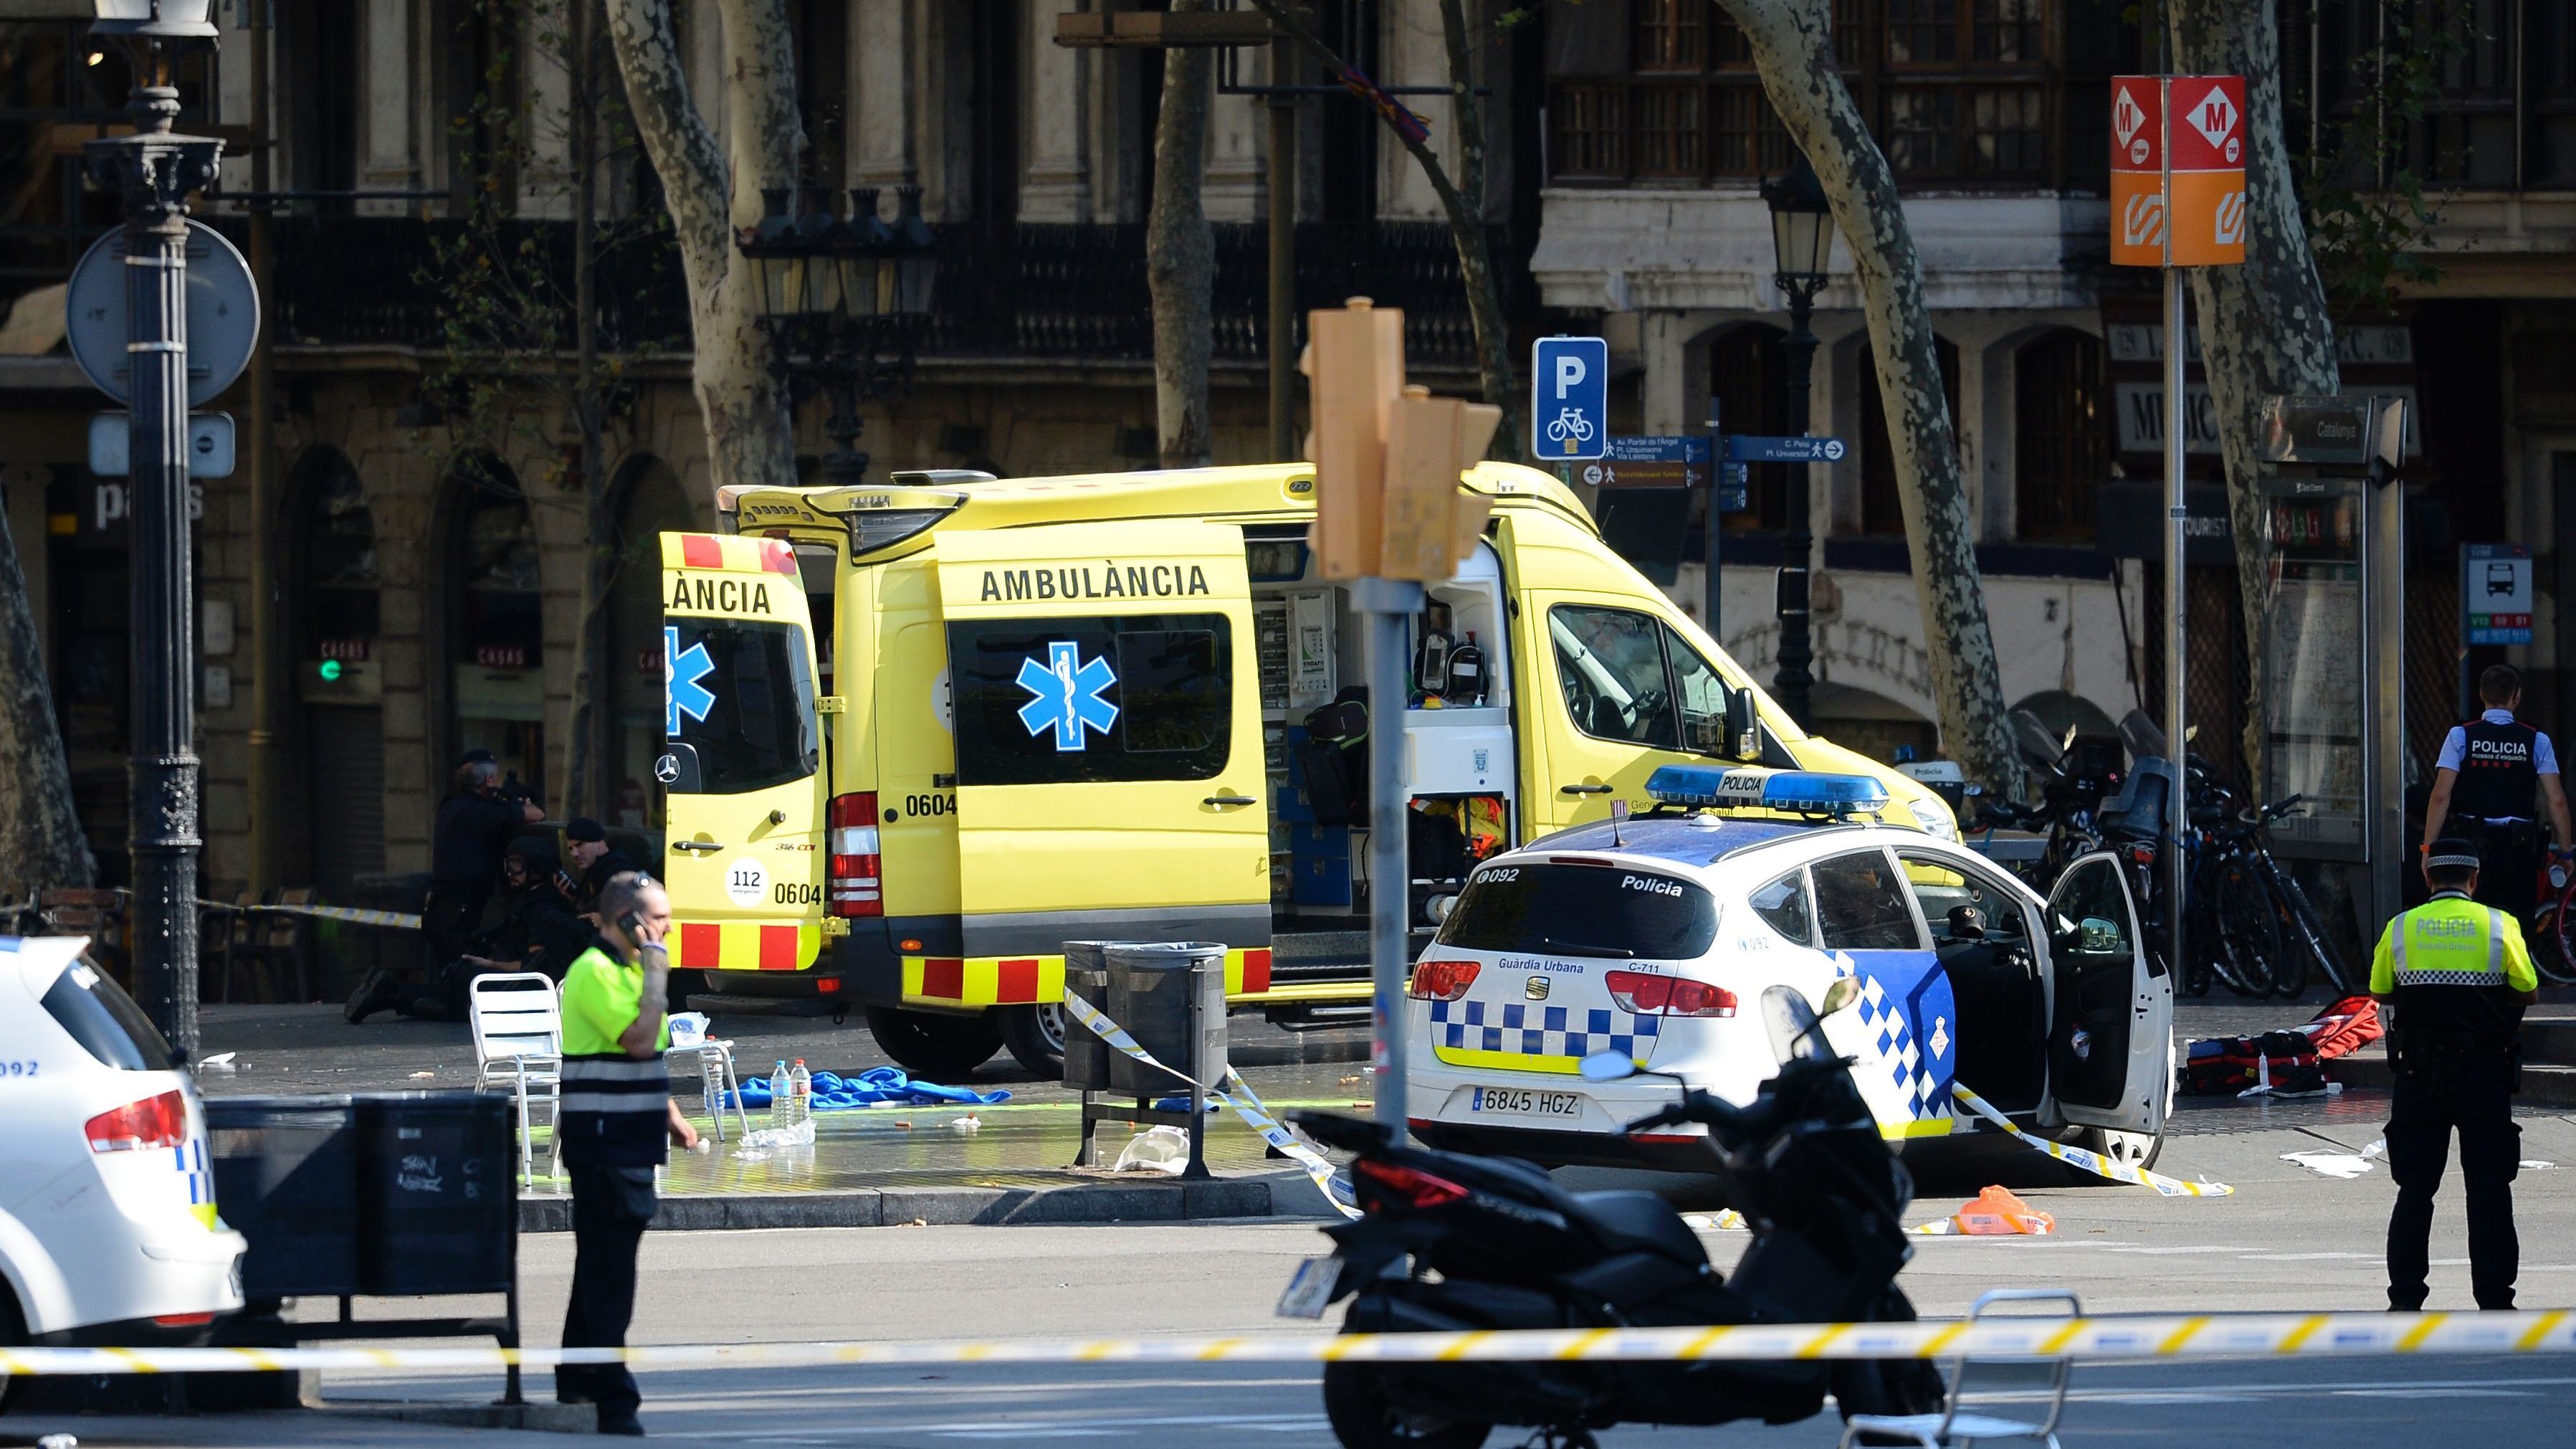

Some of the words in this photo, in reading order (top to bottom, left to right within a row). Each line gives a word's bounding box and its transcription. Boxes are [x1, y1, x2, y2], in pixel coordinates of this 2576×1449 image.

[2119, 103, 2132, 133] M
[2205, 103, 2226, 132] M
[1556, 356, 1586, 399] P
[2317, 422, 2356, 441] Catalunya
[2185, 516, 2226, 537] OURIST
[981, 559, 1210, 602] AMBULÀNCIA
[664, 570, 771, 614] ÀNCIA
[2471, 740, 2527, 755] POLICIA
[1722, 776, 1762, 792] POLICIA
[906, 794, 958, 817] 0604
[733, 870, 760, 887] 112
[1488, 868, 1520, 883] 092
[1621, 875, 1684, 898] Policia
[775, 883, 821, 906] 0604
[2416, 918, 2477, 937] POLICIA
[1499, 958, 1540, 971] Guàrdia
[1544, 960, 1585, 974] Urbana
[1628, 962, 1660, 974] C-711
[1486, 1090, 1532, 1112] 6845
[1539, 1093, 1578, 1115] HGZ
